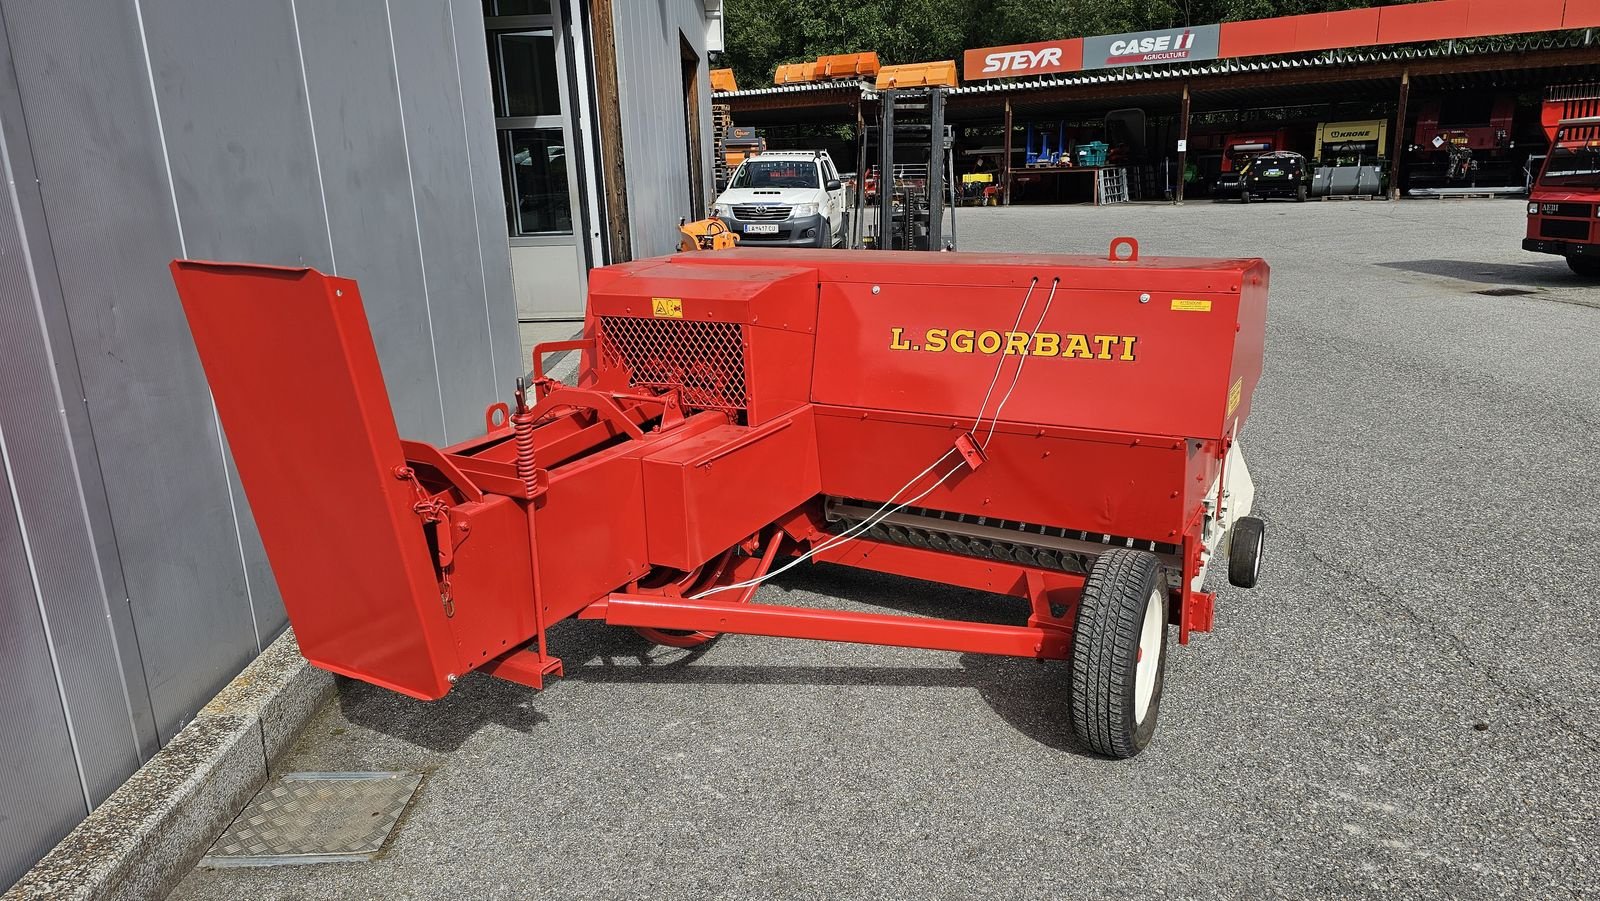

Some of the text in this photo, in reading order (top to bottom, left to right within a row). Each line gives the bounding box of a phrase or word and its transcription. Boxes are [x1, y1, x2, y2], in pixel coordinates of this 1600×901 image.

[1109, 36, 1171, 56] CASE
[1143, 51, 1186, 61] AGRICULTURE
[982, 48, 1062, 73] STEYR
